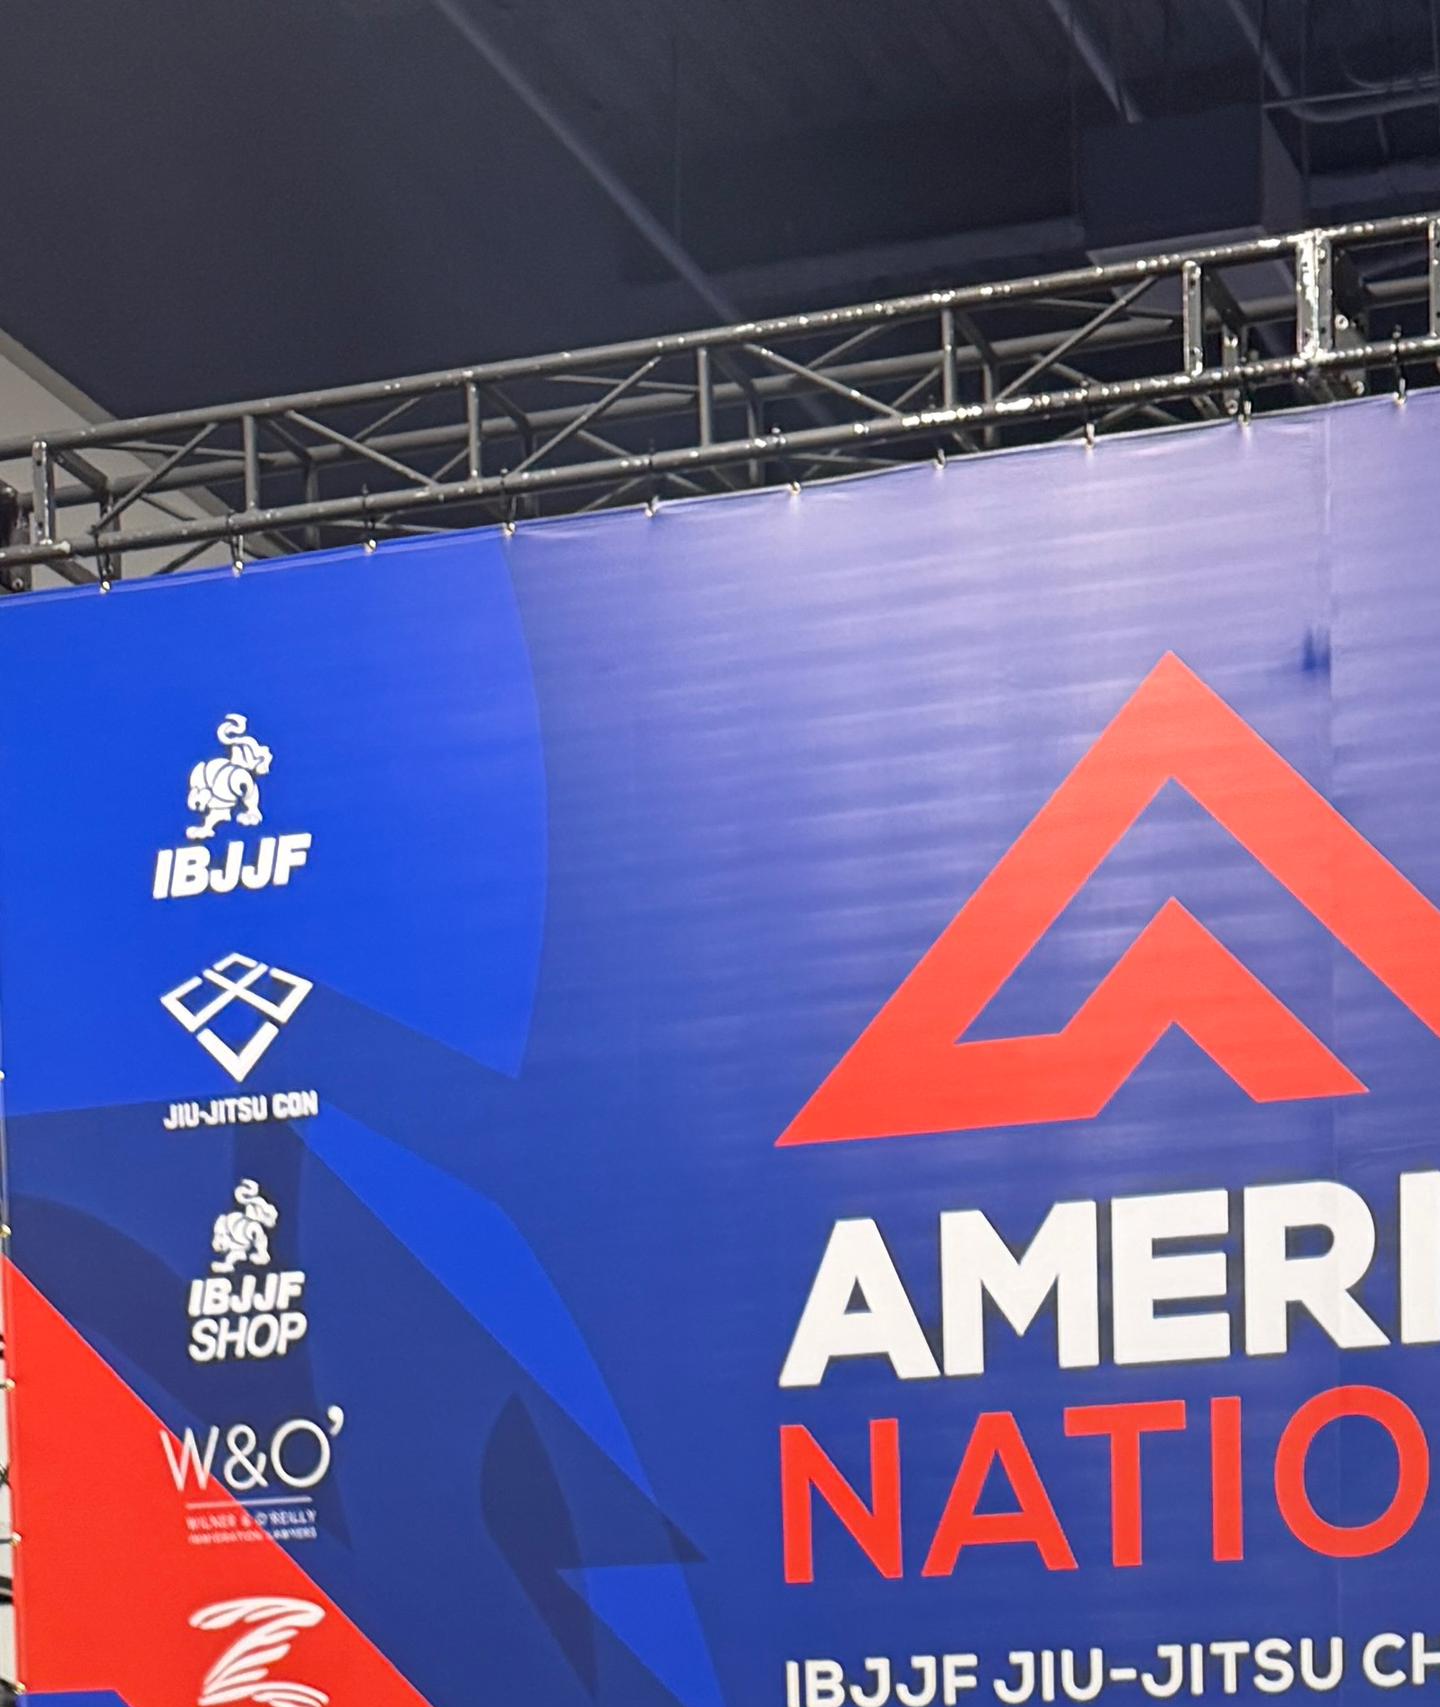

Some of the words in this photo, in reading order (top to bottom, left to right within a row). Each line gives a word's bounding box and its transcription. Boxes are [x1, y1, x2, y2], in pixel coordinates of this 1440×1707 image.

[153, 832, 312, 900] IBJJF
[163, 1094, 268, 1130] JIU-JITSU
[272, 1089, 319, 1119] CON
[188, 1271, 306, 1317] IBJJF
[188, 1312, 307, 1362] SHOP
[993, 1636, 1343, 1704] JIU-JITSU
